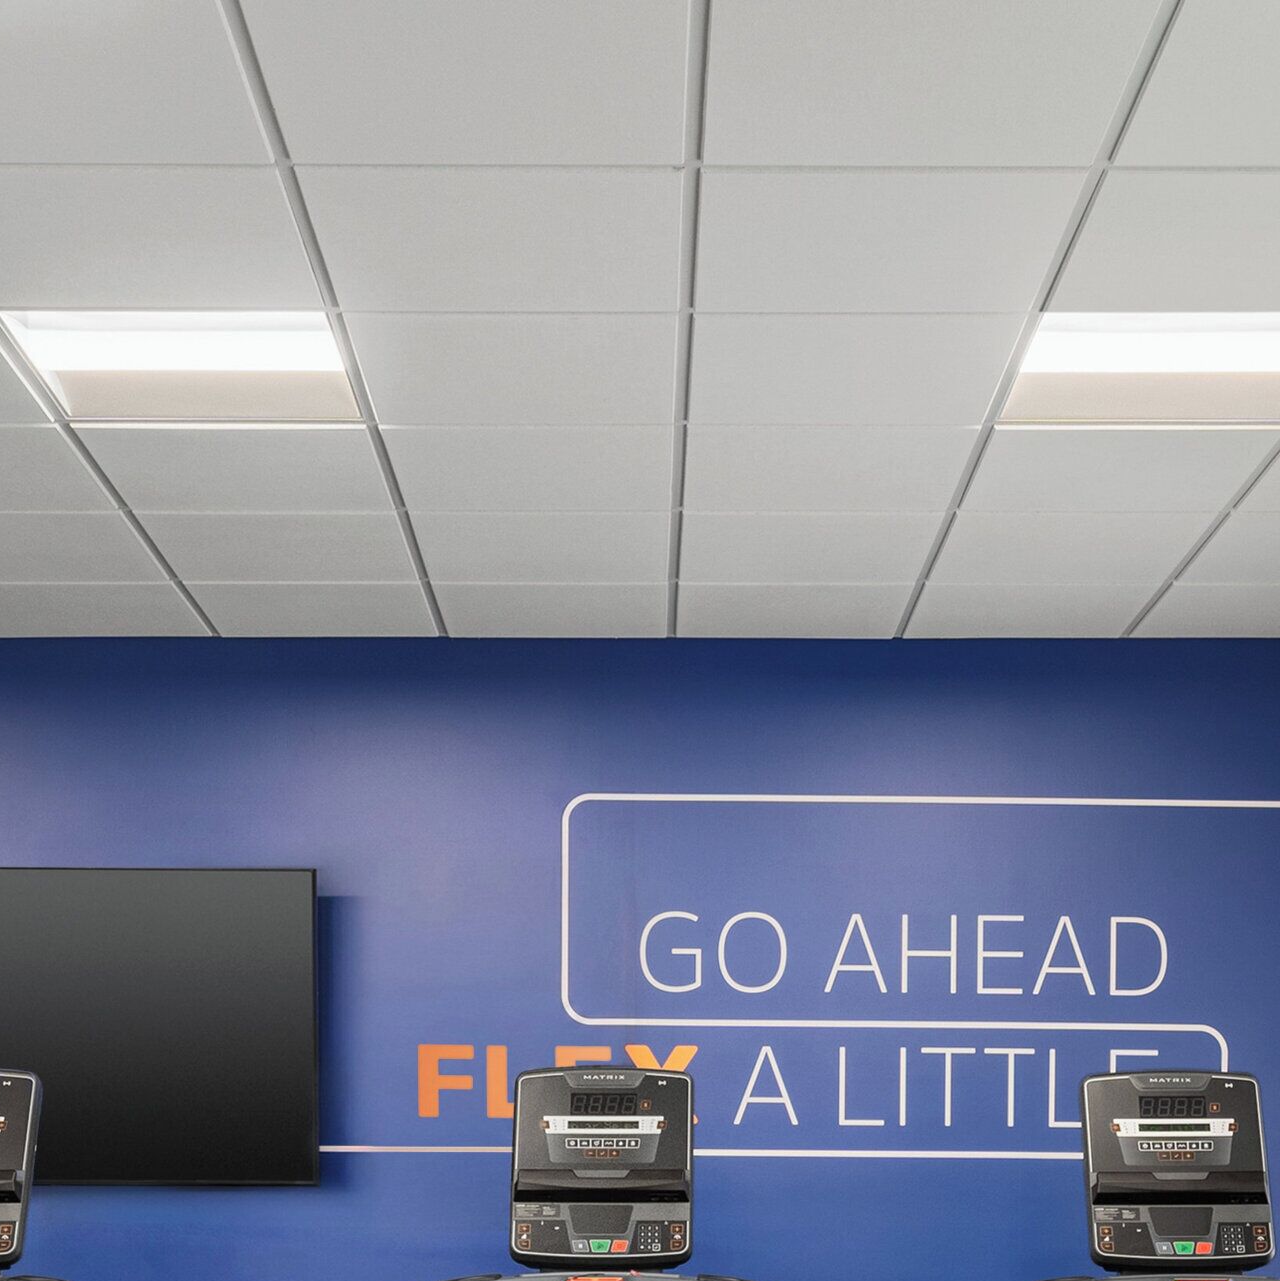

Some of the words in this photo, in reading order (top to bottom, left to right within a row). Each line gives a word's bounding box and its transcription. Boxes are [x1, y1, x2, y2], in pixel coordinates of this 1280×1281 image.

[639, 911, 787, 993] GO
[824, 913, 1168, 996] AHEAD
[733, 1045, 799, 1126] A
